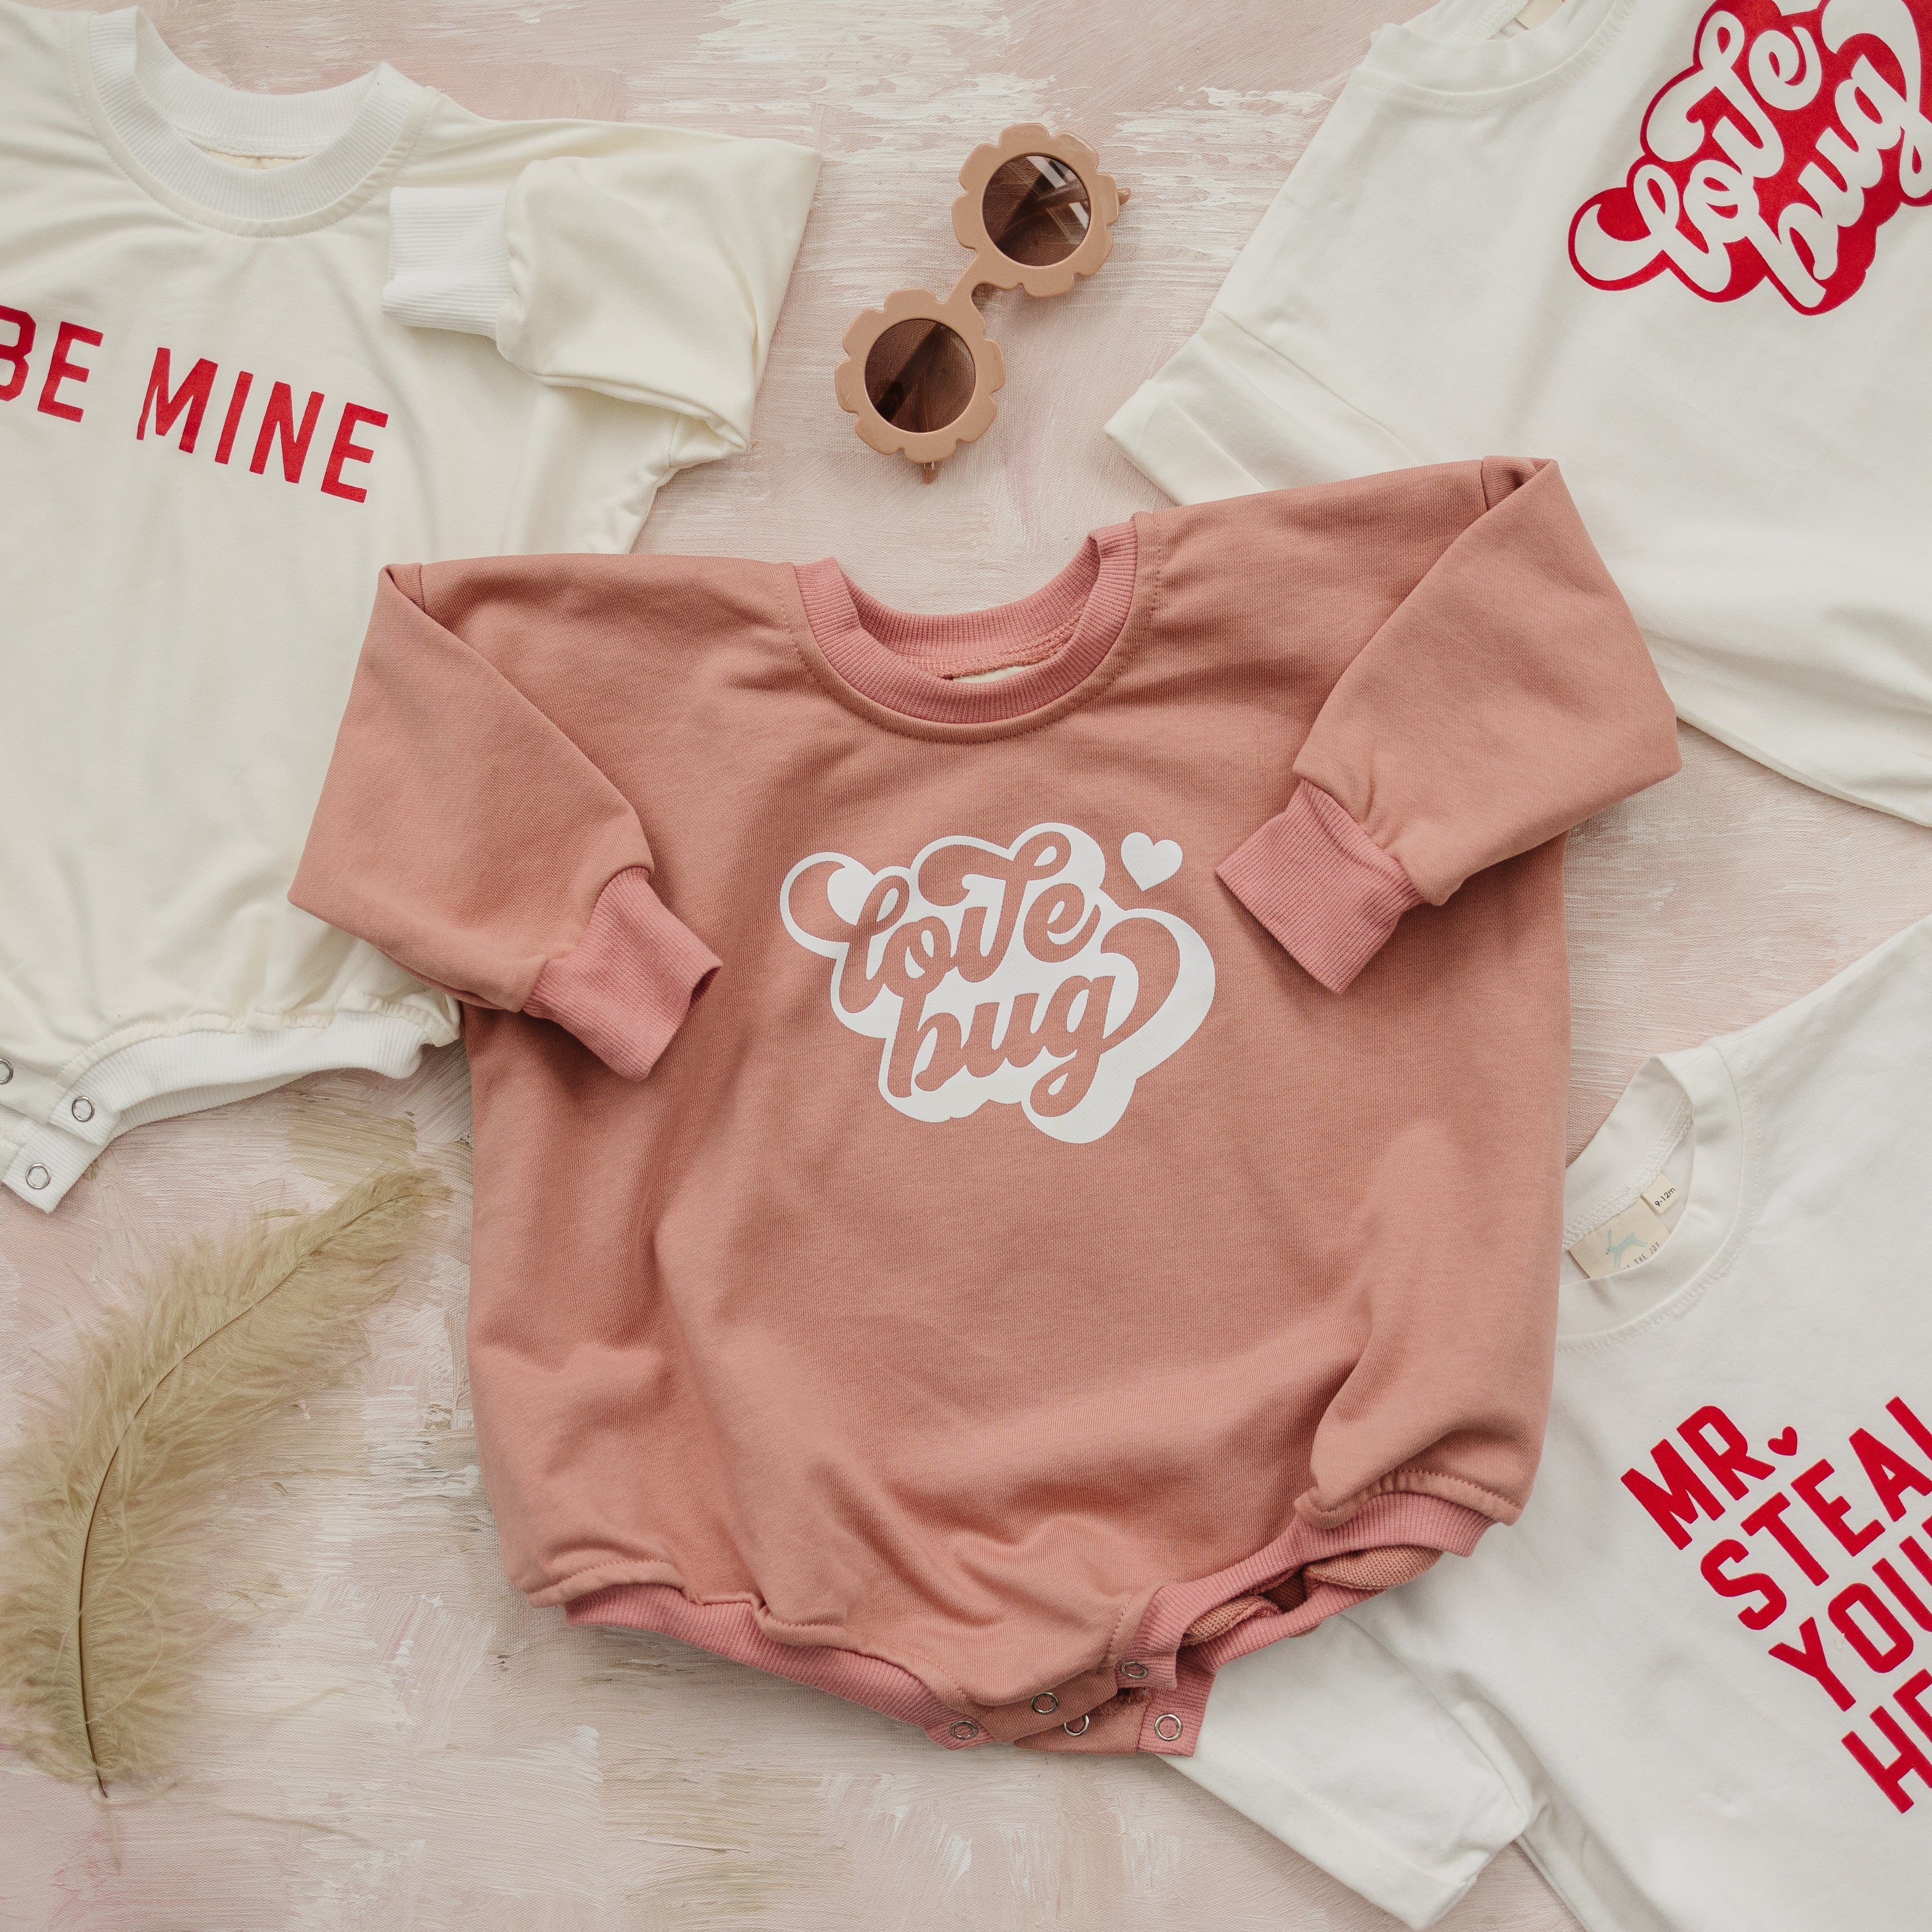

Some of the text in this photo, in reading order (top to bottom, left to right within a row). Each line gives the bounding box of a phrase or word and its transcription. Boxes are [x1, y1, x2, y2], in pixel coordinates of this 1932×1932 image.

[1575, 11, 1822, 293] love
[0, 306, 389, 503] BE MINE
[788, 831, 1101, 1013] love
[887, 917, 1180, 1117] bug
[1633, 1241, 1660, 1265] THE JOY
[1654, 1187, 1676, 1206] 9-12m
[1768, 1514, 1932, 1712] YOU
